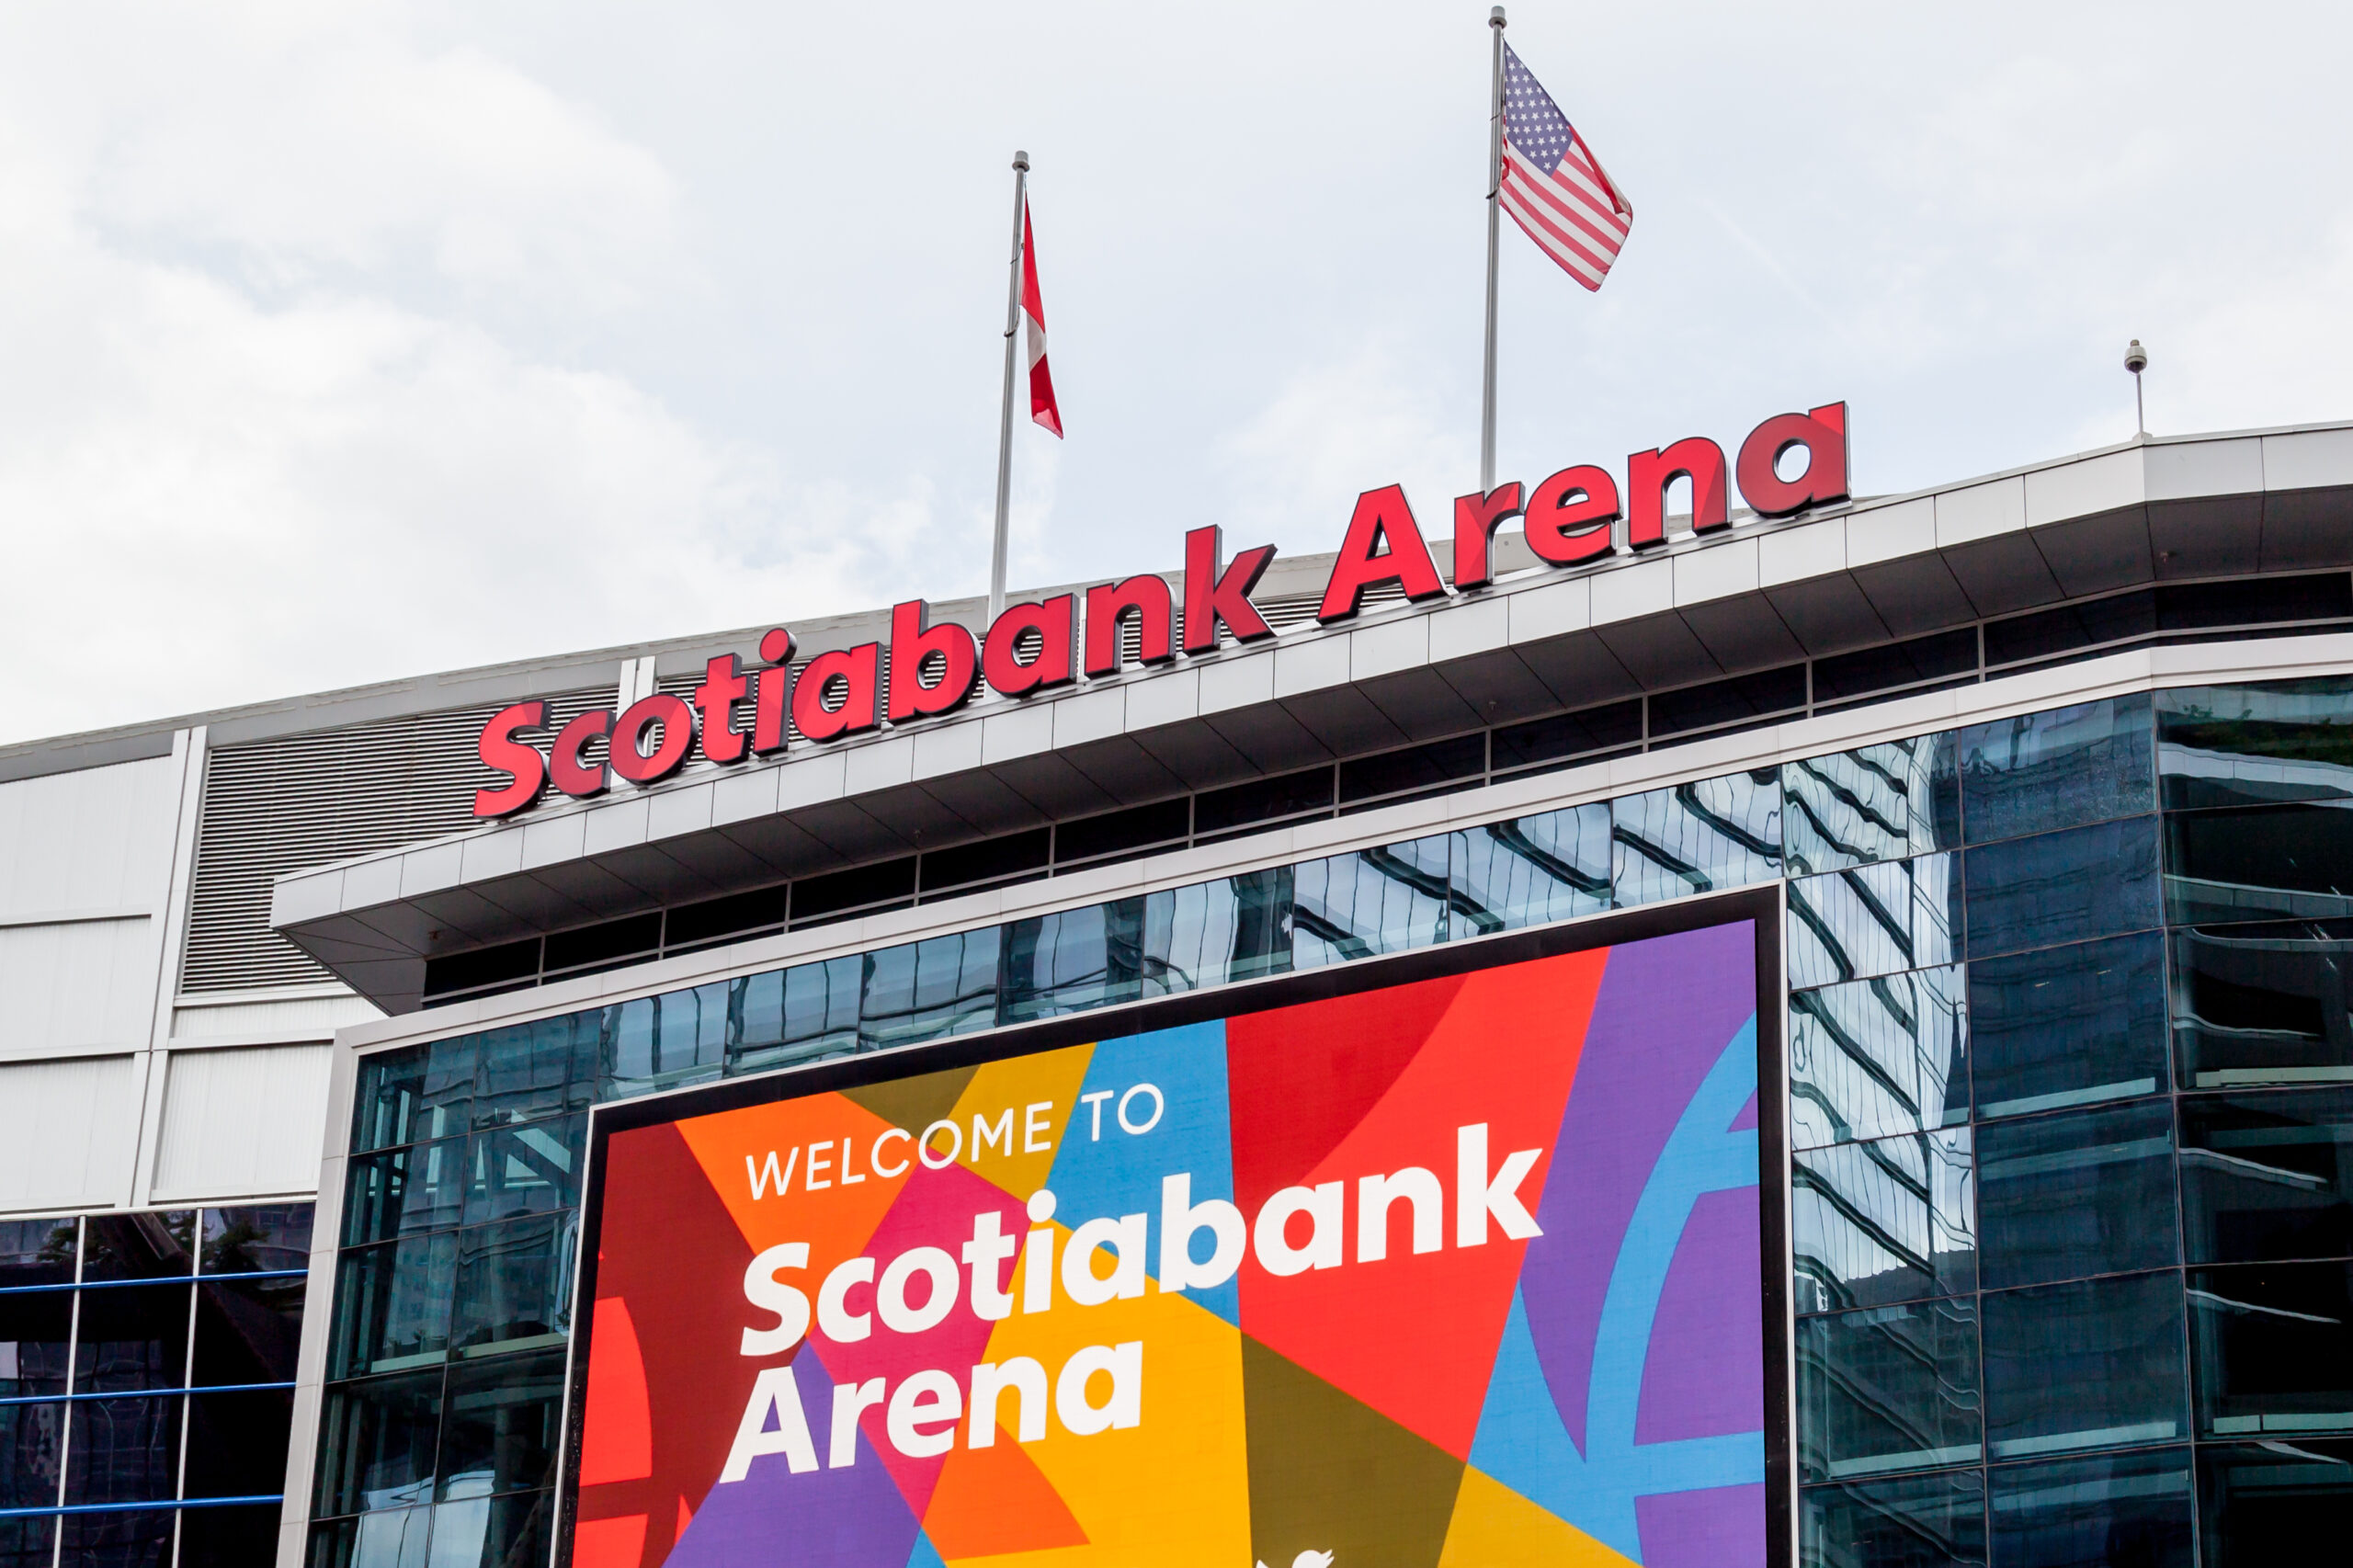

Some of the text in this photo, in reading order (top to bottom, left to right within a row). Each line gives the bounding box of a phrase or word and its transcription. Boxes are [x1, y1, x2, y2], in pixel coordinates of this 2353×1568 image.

[472, 401, 1851, 823] Scotiabank Arena
[745, 1083, 1165, 1200] WELCOME TO
[739, 1122, 1544, 1357] Scotiabank
[719, 1340, 1143, 1483] Arena
